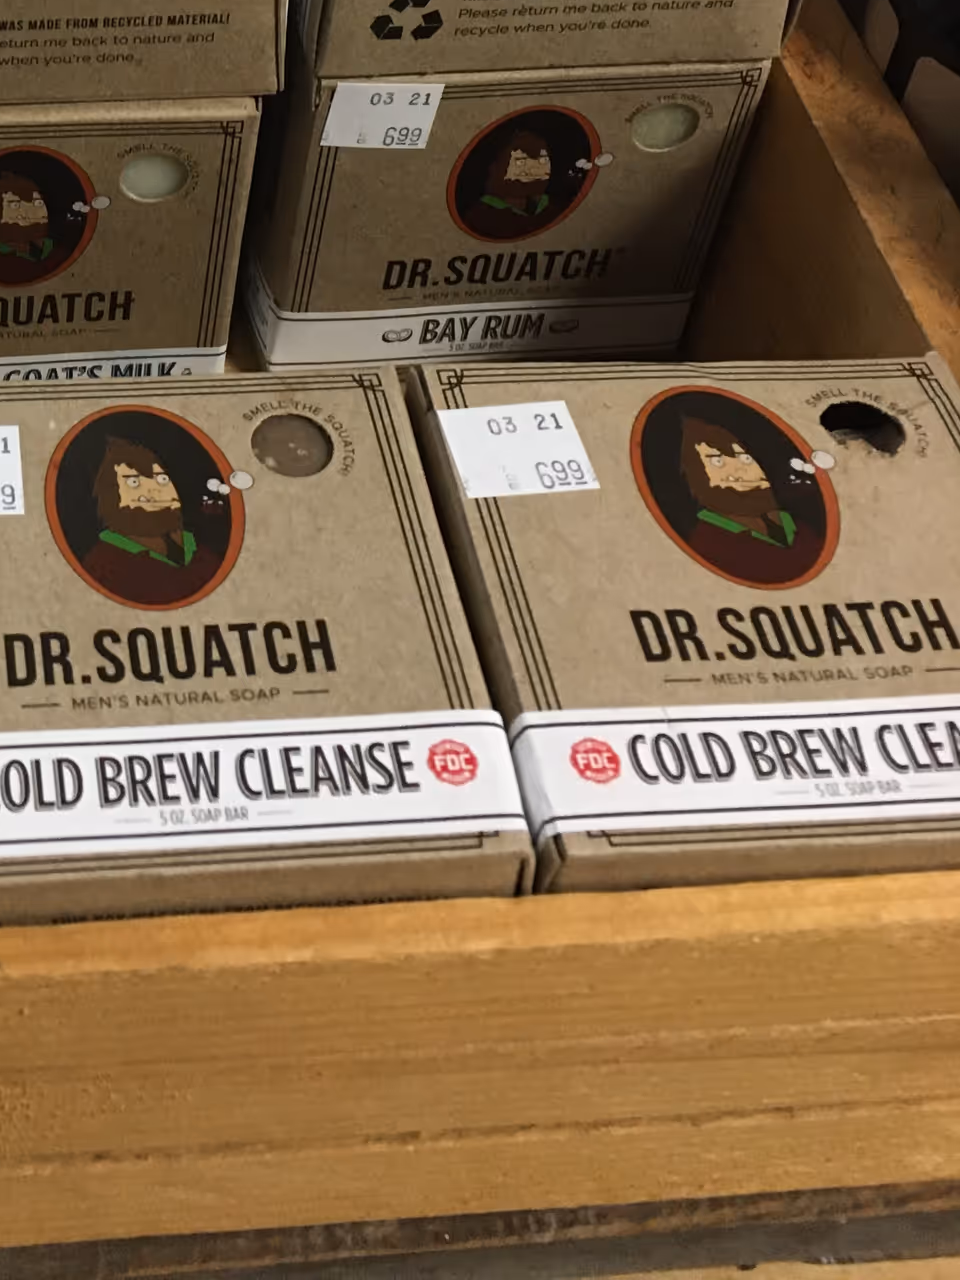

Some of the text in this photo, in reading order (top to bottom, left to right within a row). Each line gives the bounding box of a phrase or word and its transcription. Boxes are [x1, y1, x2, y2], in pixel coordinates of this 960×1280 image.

[458, 7, 508, 19] Please
[512, 5, 558, 17] return
[563, 6, 587, 14] me
[591, 2, 627, 13] back
[632, 1, 648, 11] to
[651, 0, 700, 11] nature
[28, 19, 62, 31] MADE
[65, 17, 98, 29] FROM
[102, 15, 163, 28] RECYCLED
[167, 12, 231, 26] MATERIAL!
[453, 20, 606, 37] recycle when you're
[44, 38, 67, 48] me
[71, 35, 108, 47] back
[113, 34, 129, 46] to
[133, 33, 182, 45] nature
[186, 31, 215, 43] and
[43, 52, 91, 67] you're
[369, 92, 431, 106] 03 21
[382, 126, 422, 147] 699
[382, 248, 613, 290] DR.SQUATCH
[50, 328, 88, 337] SOAP
[419, 313, 545, 345] BAY RUM
[805, 388, 848, 407] SMELL
[852, 388, 882, 404] THE
[487, 412, 563, 435] 03 21
[243, 400, 356, 477] SMELL THE SQUATCH
[535, 459, 588, 489] 699
[630, 597, 960, 665] DR.SQUATCH
[4, 618, 337, 688] DR.SQUATCH
[712, 665, 913, 686] MEN'S NATURAL SOAP
[72, 687, 281, 711] MEN'S NATURAL SOAP
[433, 753, 474, 771] FDC
[575, 752, 617, 770] FDC
[628, 730, 737, 785] COLD
[741, 725, 870, 782] BREW
[97, 748, 221, 809] BREW
[234, 741, 421, 800] CLEANSE
[849, 780, 877, 796] SOAP
[880, 779, 902, 795] BAR
[160, 806, 249, 826] 5 SOAP BAR
